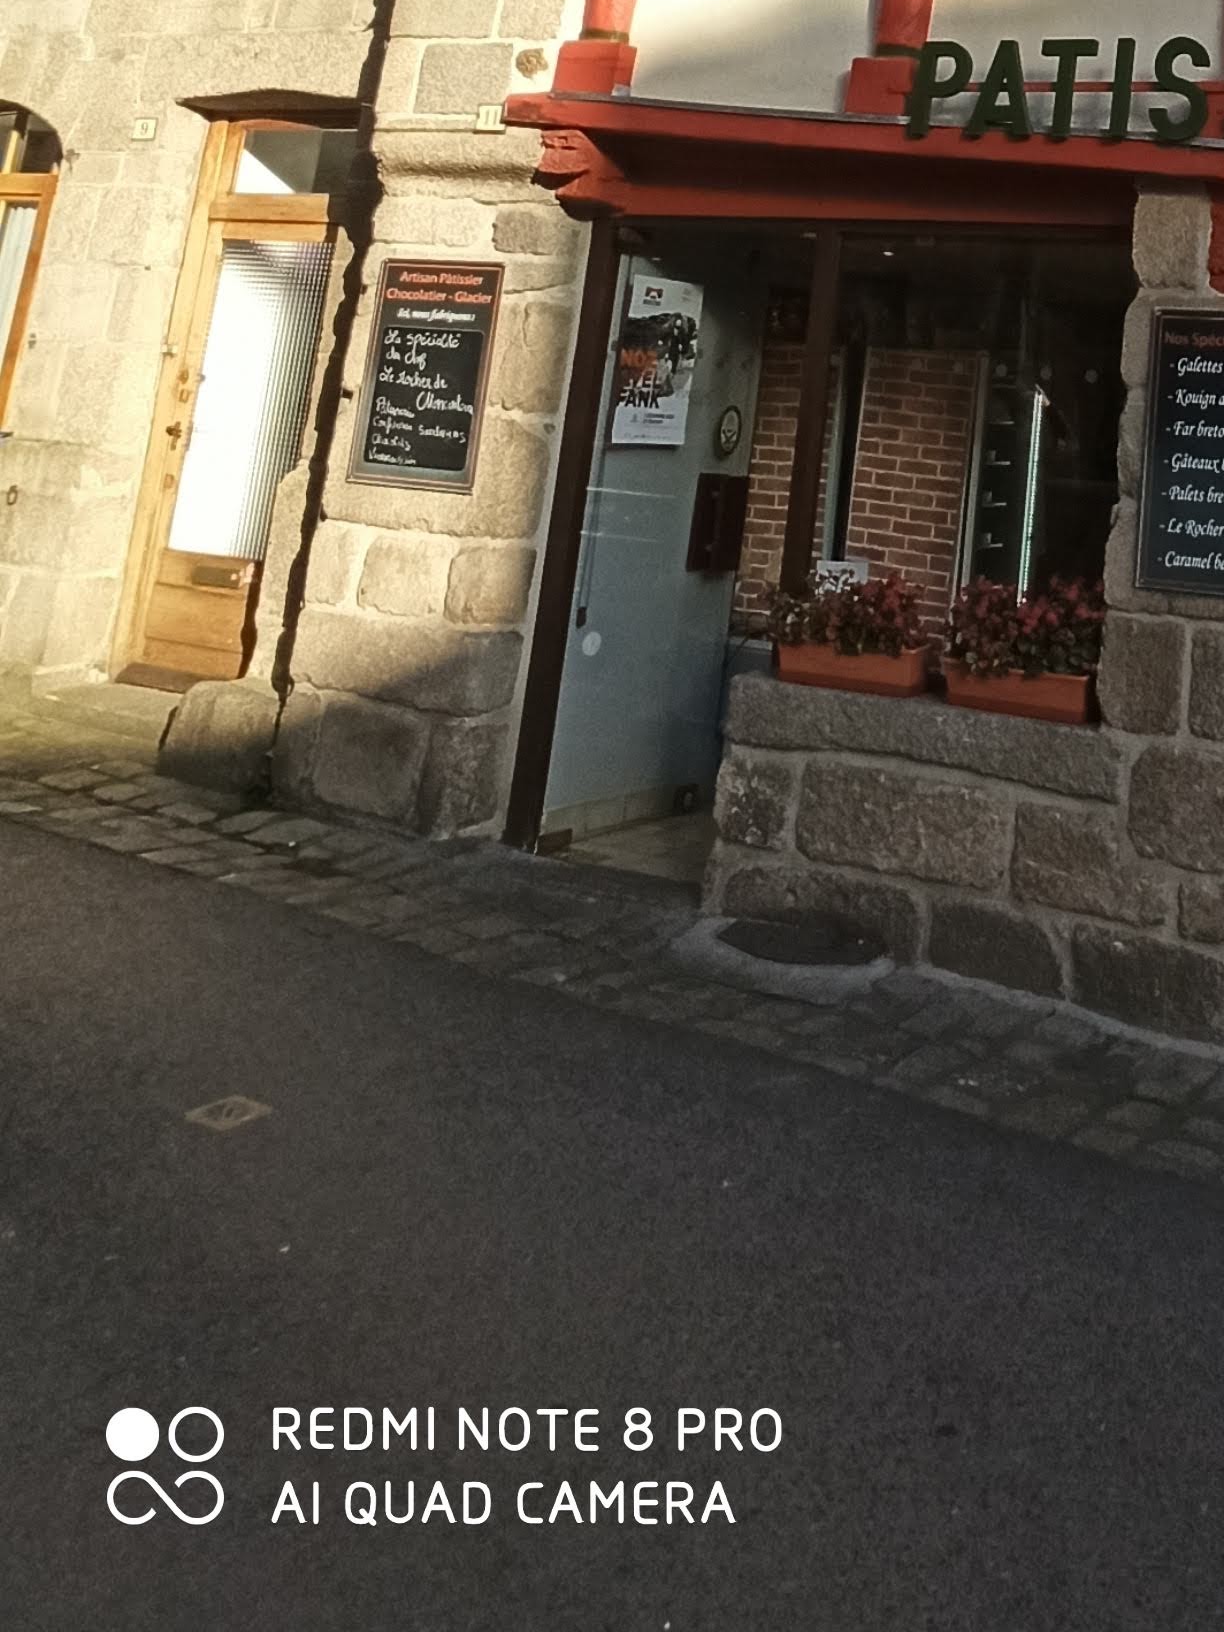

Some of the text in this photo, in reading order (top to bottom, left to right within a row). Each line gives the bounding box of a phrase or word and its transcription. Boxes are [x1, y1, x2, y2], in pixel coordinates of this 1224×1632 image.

[141, 122, 149, 136] 9
[400, 271, 438, 283] Artisan
[386, 288, 447, 301] Chocolatier
[454, 290, 492, 303] Glacier
[1164, 331, 1189, 345] Nos
[1177, 356, 1223, 376] Galettes
[1175, 388, 1216, 409] Kouign
[1173, 421, 1195, 436] Far
[1171, 452, 1220, 473] Gâteaux
[1169, 484, 1205, 502] Palets
[1167, 518, 1183, 533] Le
[1185, 519, 1224, 538] Rocher
[1165, 550, 1214, 569] Caramel
